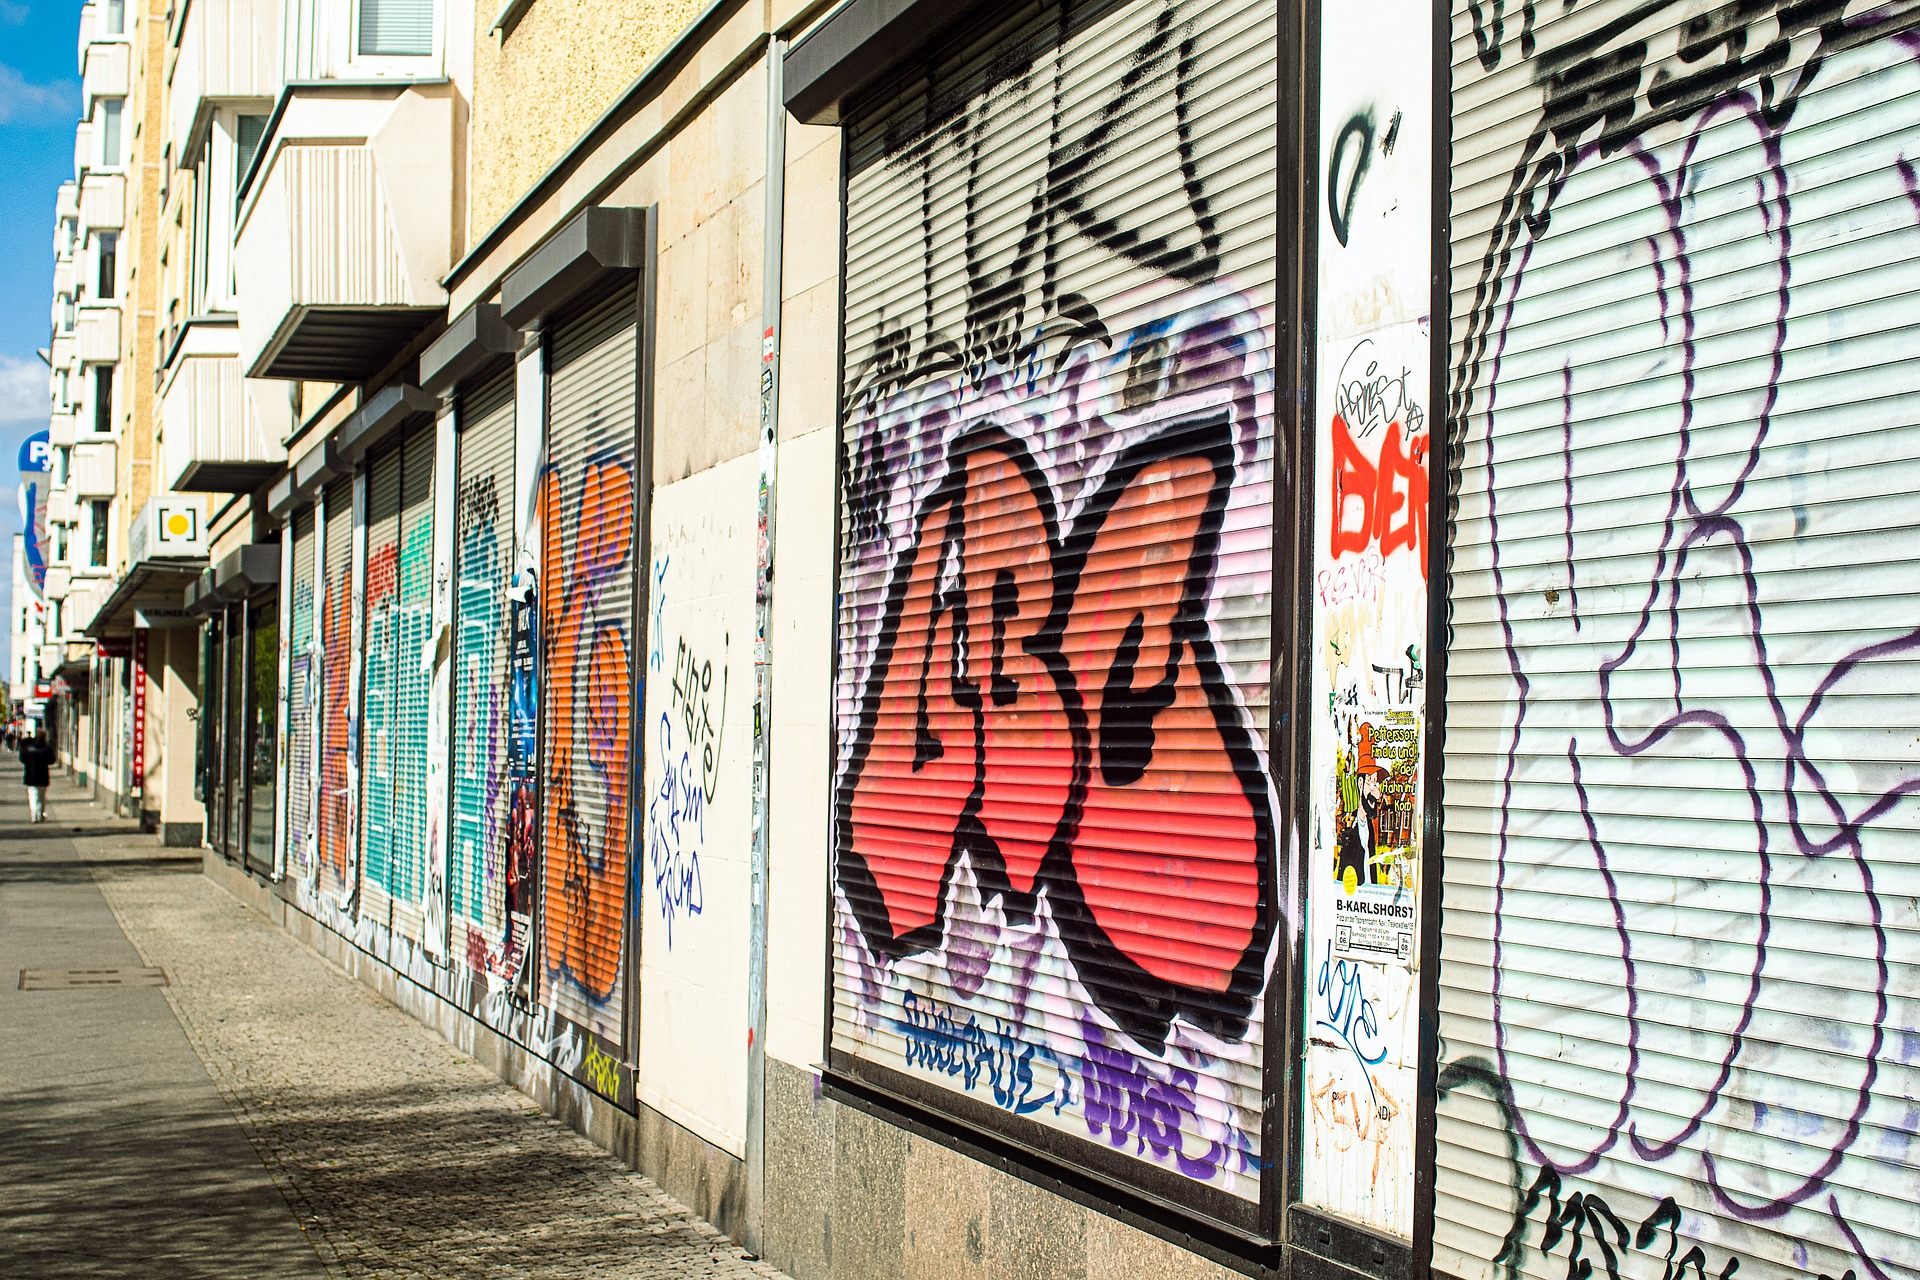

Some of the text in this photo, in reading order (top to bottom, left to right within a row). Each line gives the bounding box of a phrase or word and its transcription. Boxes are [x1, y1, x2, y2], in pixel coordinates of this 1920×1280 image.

[1381, 779, 1403, 793] Hahn
[1394, 796, 1412, 812] Korb
[1336, 898, 1414, 919] B-KARLSHORST
